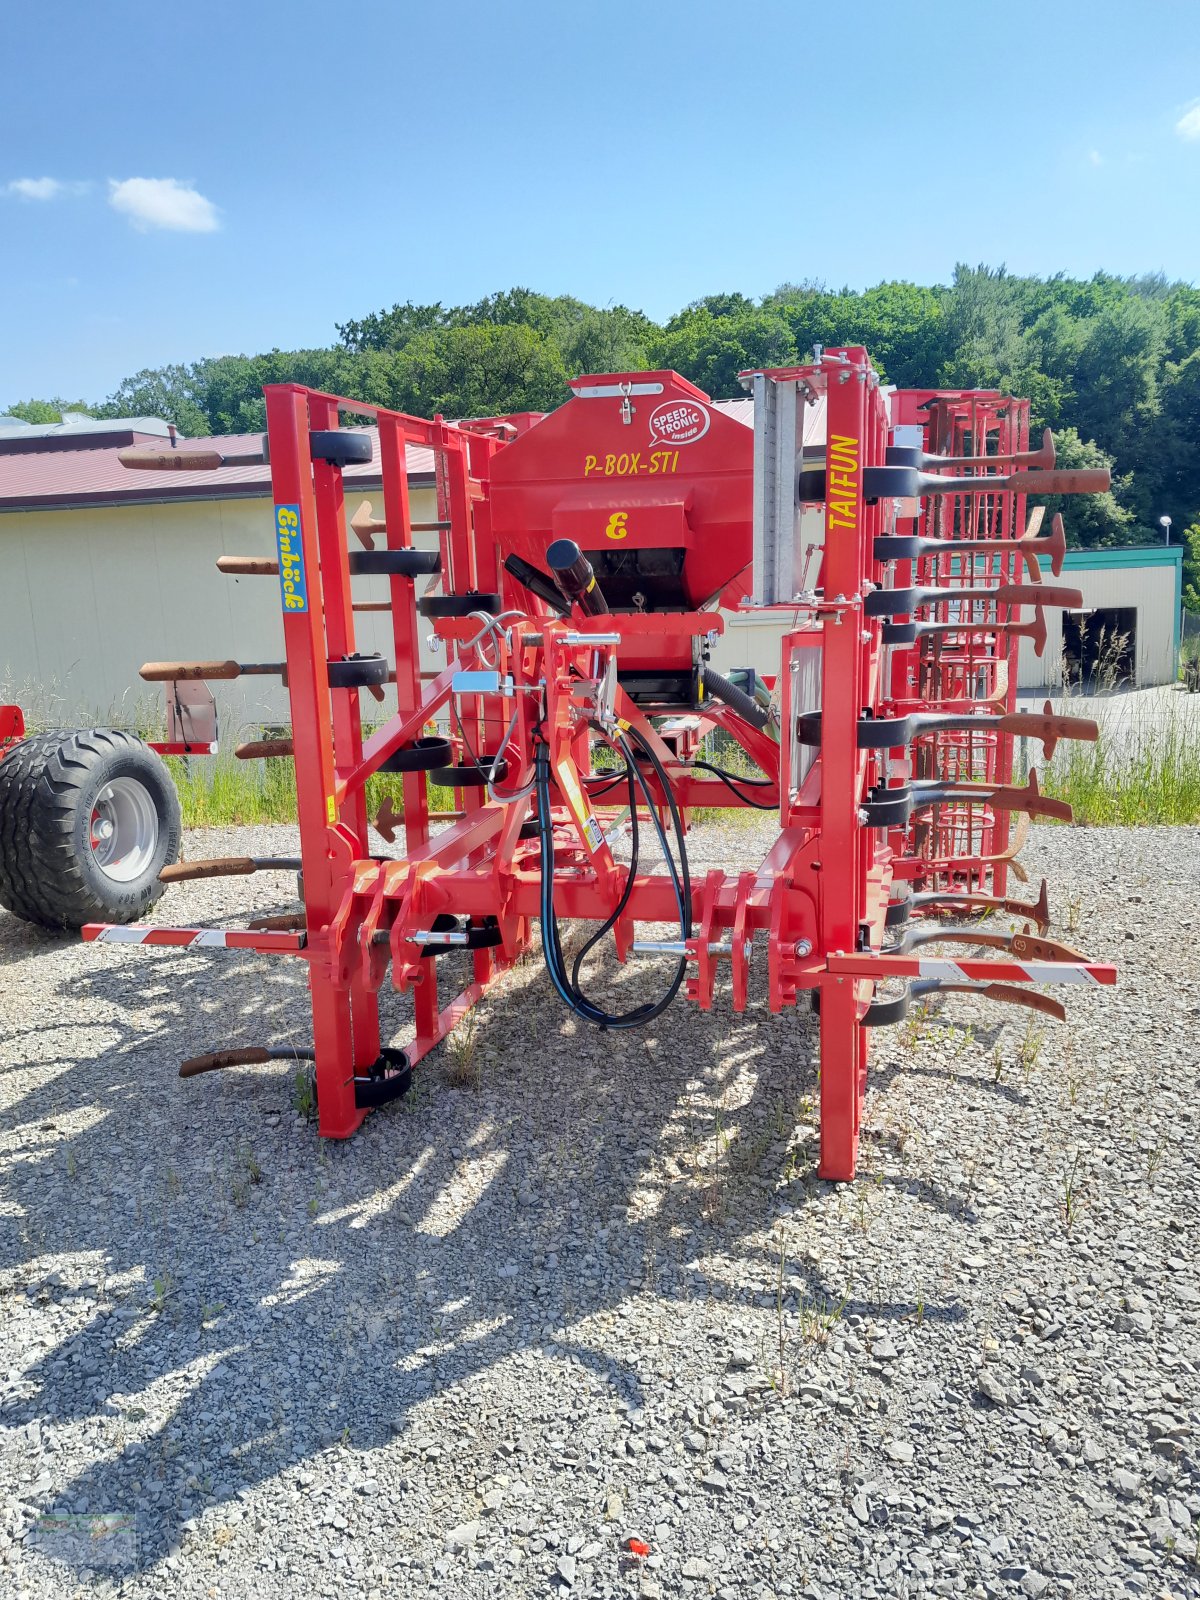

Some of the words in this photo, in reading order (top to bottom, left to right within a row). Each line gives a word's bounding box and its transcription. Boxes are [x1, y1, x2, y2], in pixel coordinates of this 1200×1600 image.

[653, 407, 692, 428] SPEED-
[659, 412, 700, 435] TRONIC
[671, 427, 698, 440] inside
[584, 450, 679, 477] P-BOX-STI
[829, 434, 859, 530] TAIFUN
[277, 507, 305, 609] Einböck
